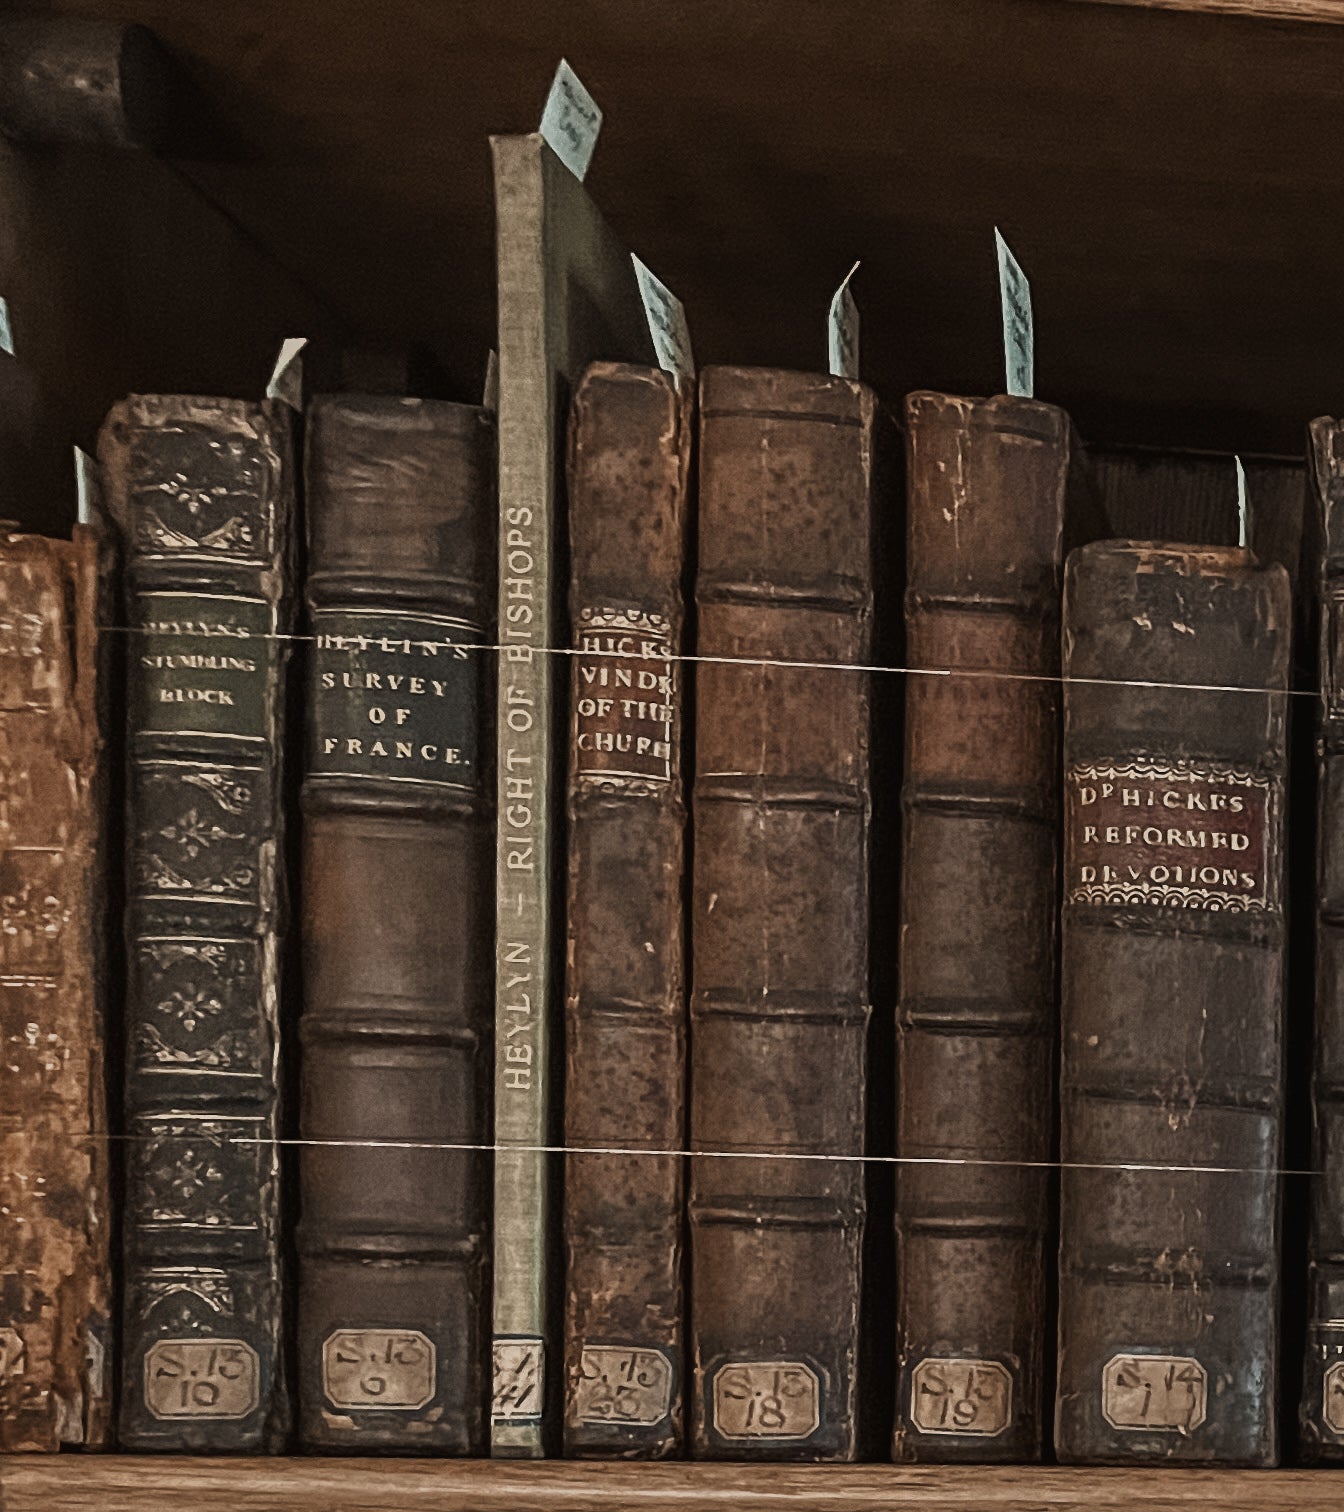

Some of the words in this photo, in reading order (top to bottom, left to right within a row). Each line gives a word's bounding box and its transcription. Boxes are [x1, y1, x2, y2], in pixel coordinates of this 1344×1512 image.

[507, 504, 533, 664] BISHOPS
[321, 672, 447, 697] SURVEY
[368, 706, 411, 724] OF
[507, 692, 532, 731] OF
[577, 698, 614, 717] OF
[323, 738, 471, 766] FRANCE.
[505, 750, 532, 872] RIGHT
[1121, 787, 1245, 813] HICKES
[1082, 826, 1250, 851] REFORMED
[1081, 865, 1256, 890] DEVOTIONS
[506, 942, 531, 1090] HEYLYN
[746, 1398, 787, 1430] 18
[940, 1396, 980, 1427] 19
